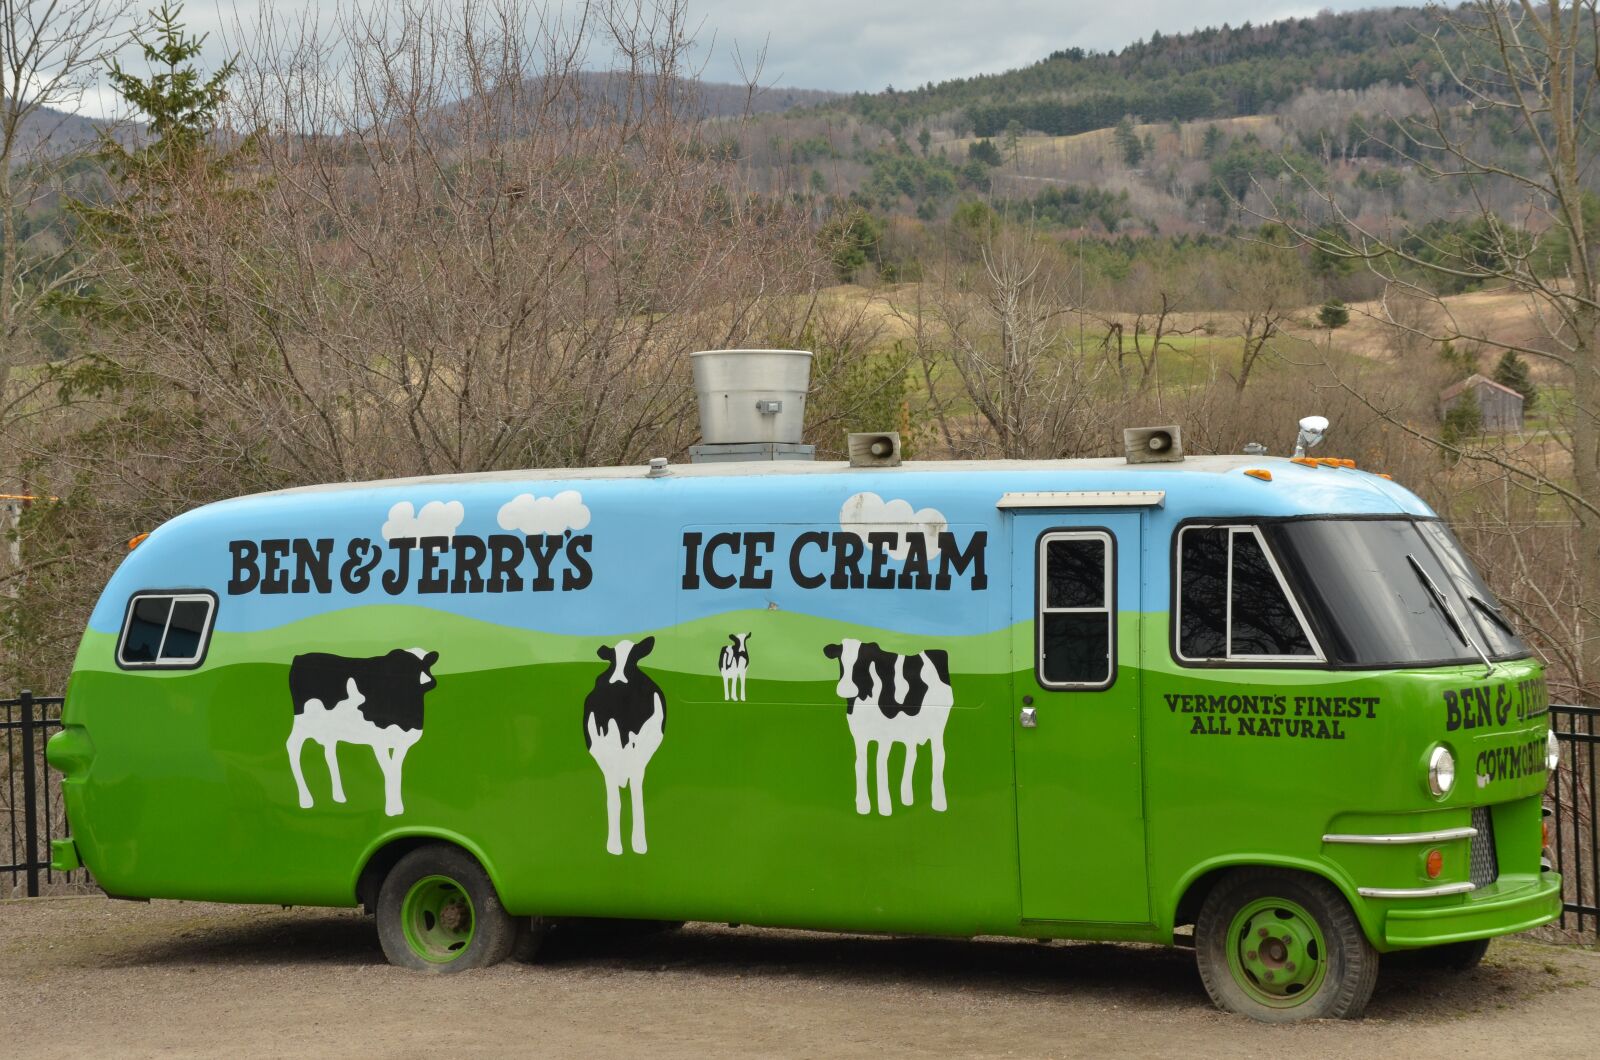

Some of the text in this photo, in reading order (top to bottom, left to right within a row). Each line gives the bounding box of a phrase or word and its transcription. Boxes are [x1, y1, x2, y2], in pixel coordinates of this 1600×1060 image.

[228, 530, 593, 595] BEN & JERRY'S
[682, 531, 988, 590] ICE CREAM
[1164, 694, 1380, 718] VERMONT'S FINEST
[1190, 716, 1345, 739] ALL NATURAL
[1443, 686, 1493, 732] BEN
[1495, 683, 1513, 726] &
